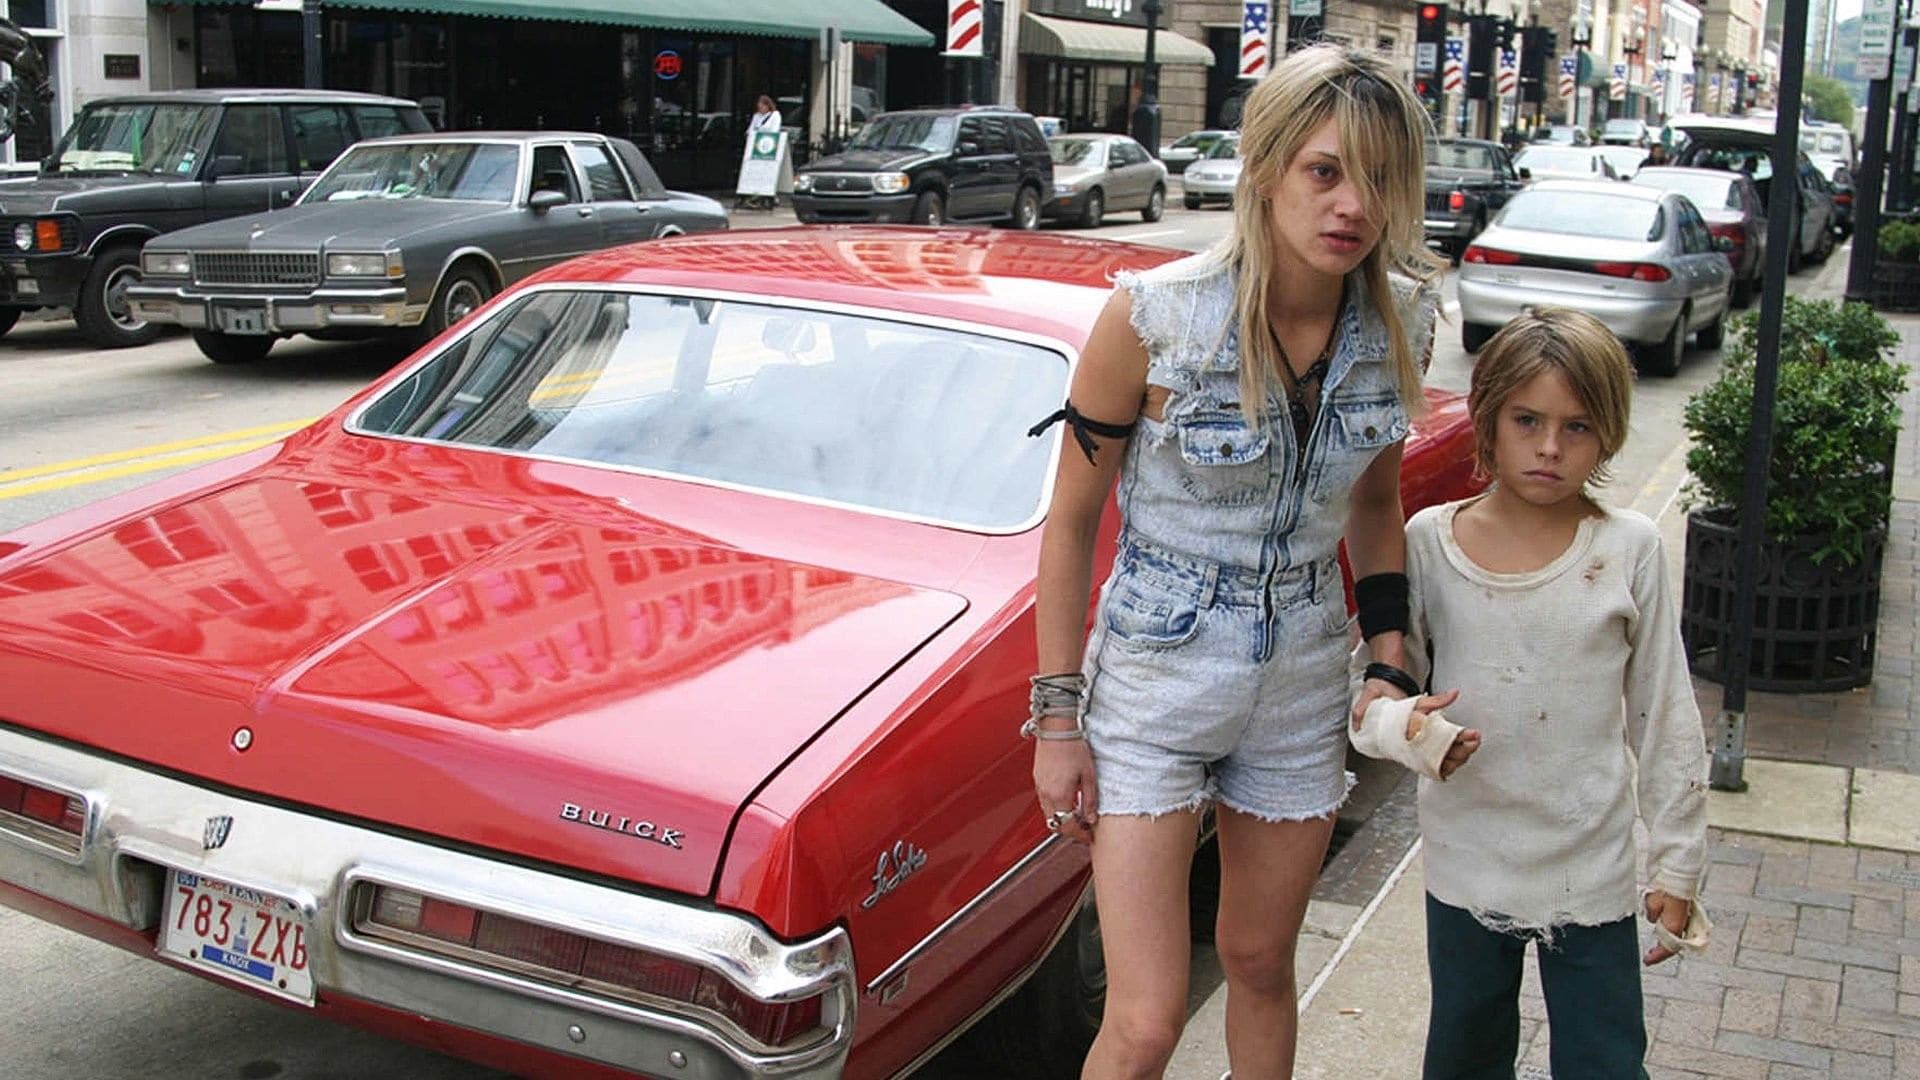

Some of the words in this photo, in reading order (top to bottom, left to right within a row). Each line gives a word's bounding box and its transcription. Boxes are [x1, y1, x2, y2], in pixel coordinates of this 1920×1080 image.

[560, 802, 685, 849] BUICK
[177, 885, 233, 946] 783
[250, 910, 308, 970] ZXB
[221, 951, 251, 970] KNOX
